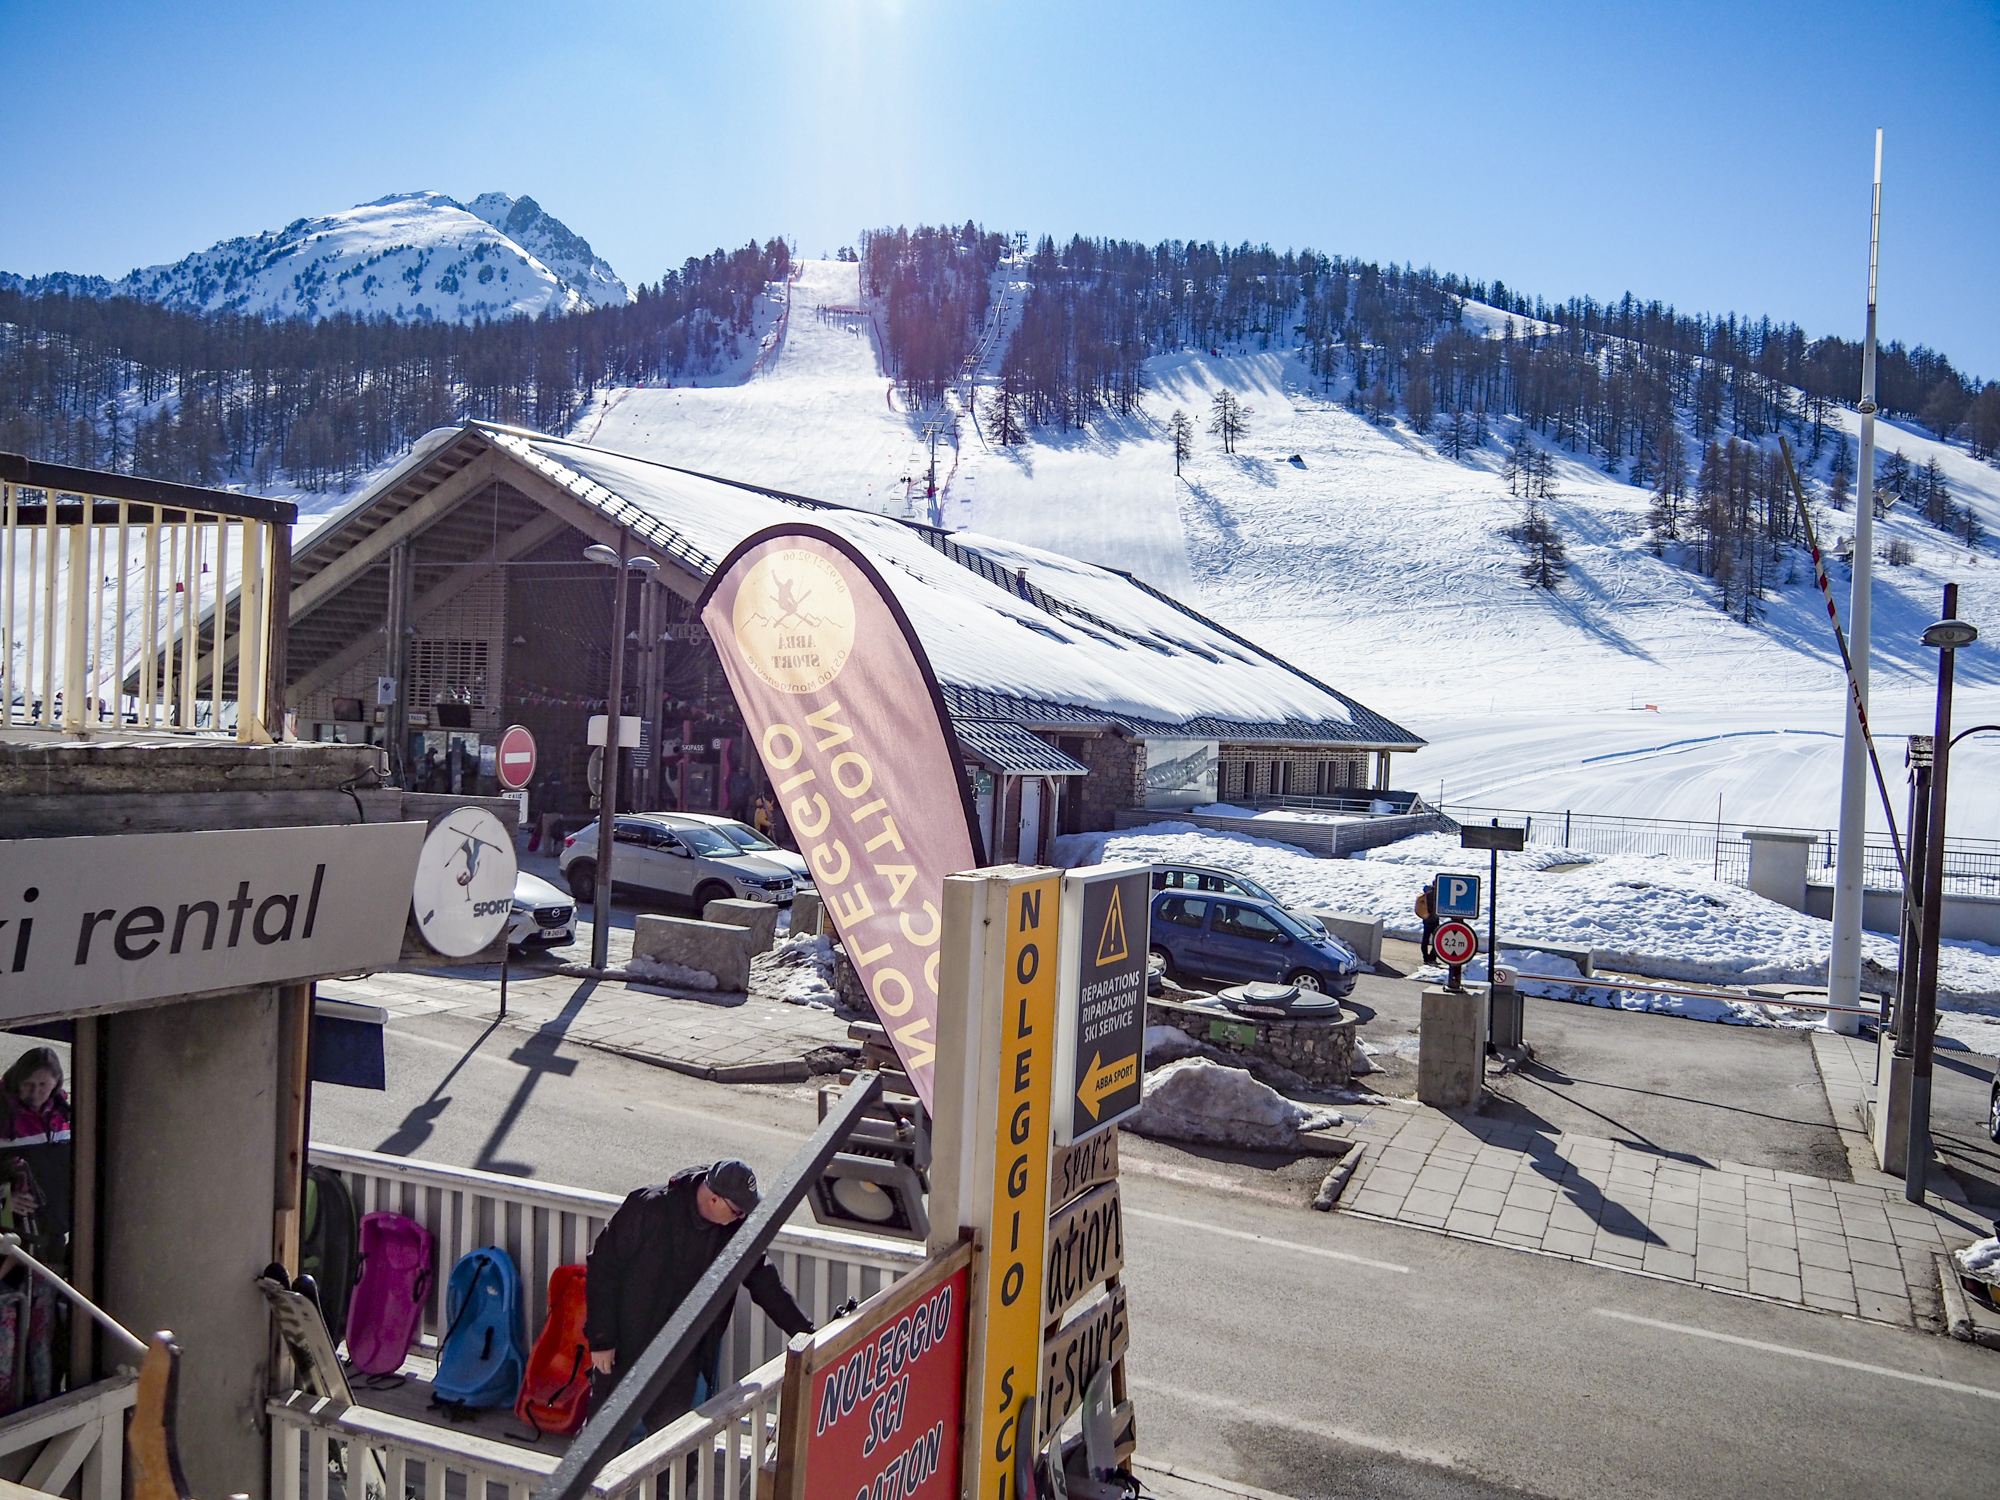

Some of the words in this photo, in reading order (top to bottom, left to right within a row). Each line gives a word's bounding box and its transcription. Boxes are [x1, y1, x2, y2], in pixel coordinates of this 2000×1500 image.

[473, 898, 513, 918] SPORT
[1449, 879, 1468, 906] P
[0, 887, 39, 974] i
[74, 863, 326, 966] rental
[1444, 938, 1456, 947] 2,2
[1081, 970, 1140, 1004] RÉPARATIONS
[1082, 990, 1138, 1024] RIPARAZIONI
[1084, 1022, 1098, 1043] SKI
[1099, 1010, 1134, 1037] SERVICE
[1094, 1074, 1113, 1092] ABBA
[1113, 1064, 1134, 1083] SPORT
[1001, 888, 1041, 1307] NOLEGGIO
[816, 1284, 952, 1437] NOLEGGIO
[862, 1373, 910, 1459] SCI
